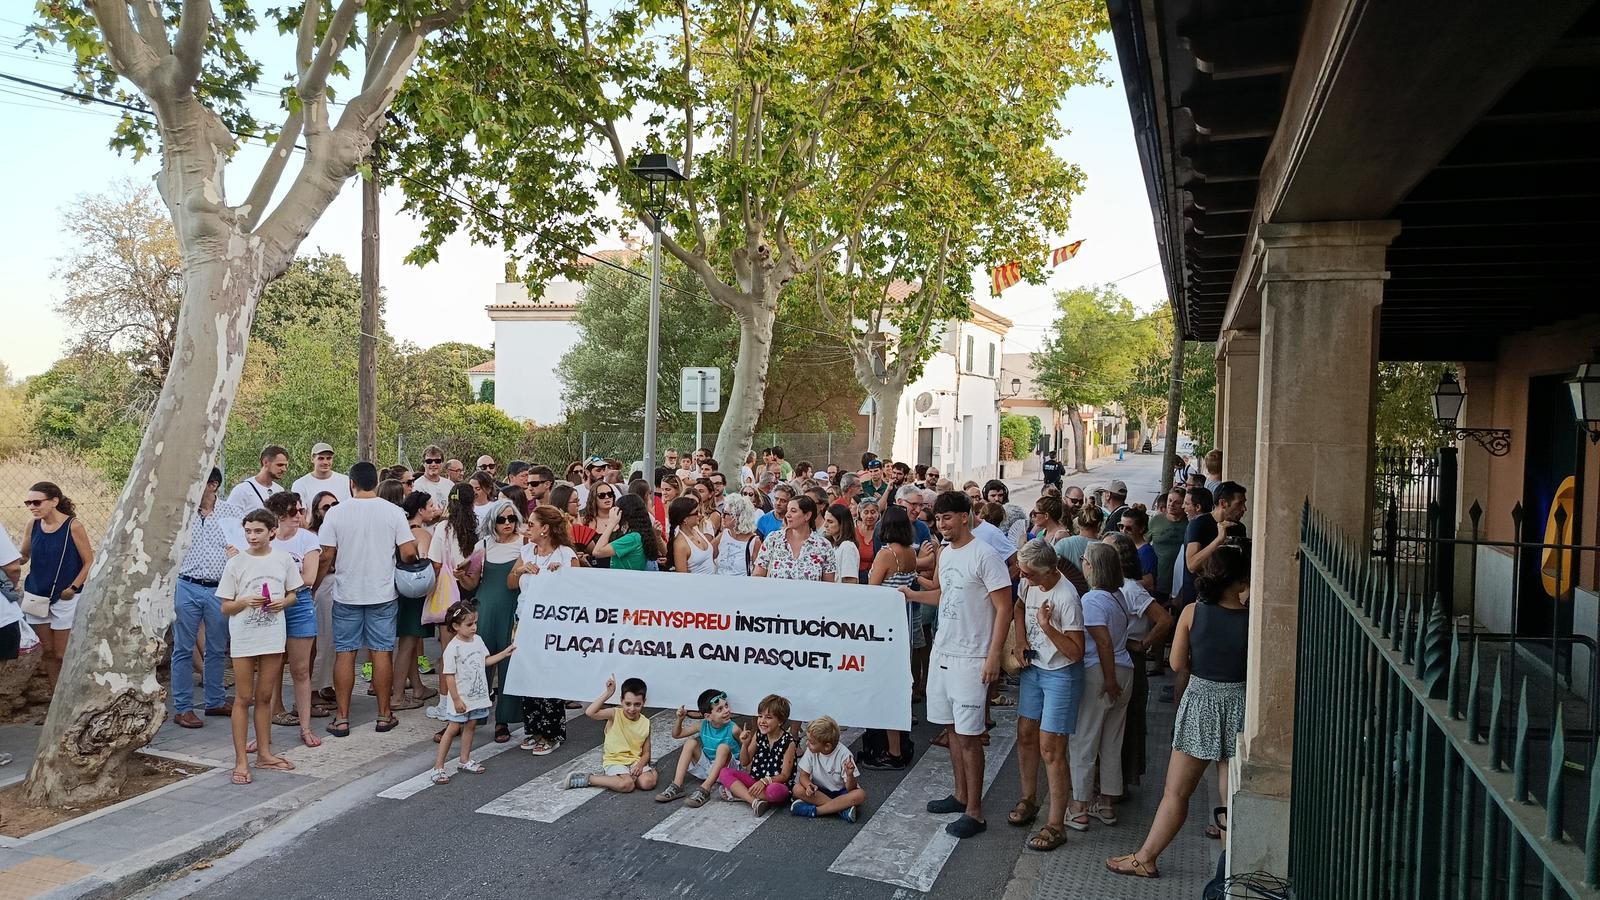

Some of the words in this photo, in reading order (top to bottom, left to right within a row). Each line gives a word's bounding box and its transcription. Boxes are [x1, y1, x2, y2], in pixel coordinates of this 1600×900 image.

[532, 604, 589, 624] BASTA
[595, 607, 619, 624] DE
[622, 608, 731, 631] MENYSPREU
[544, 633, 604, 658] PLAÇA
[618, 638, 677, 659] CASAL
[680, 642, 695, 659] A
[698, 642, 739, 663] CAN
[743, 646, 834, 673] PASQUET,
[837, 654, 865, 673] JA!
